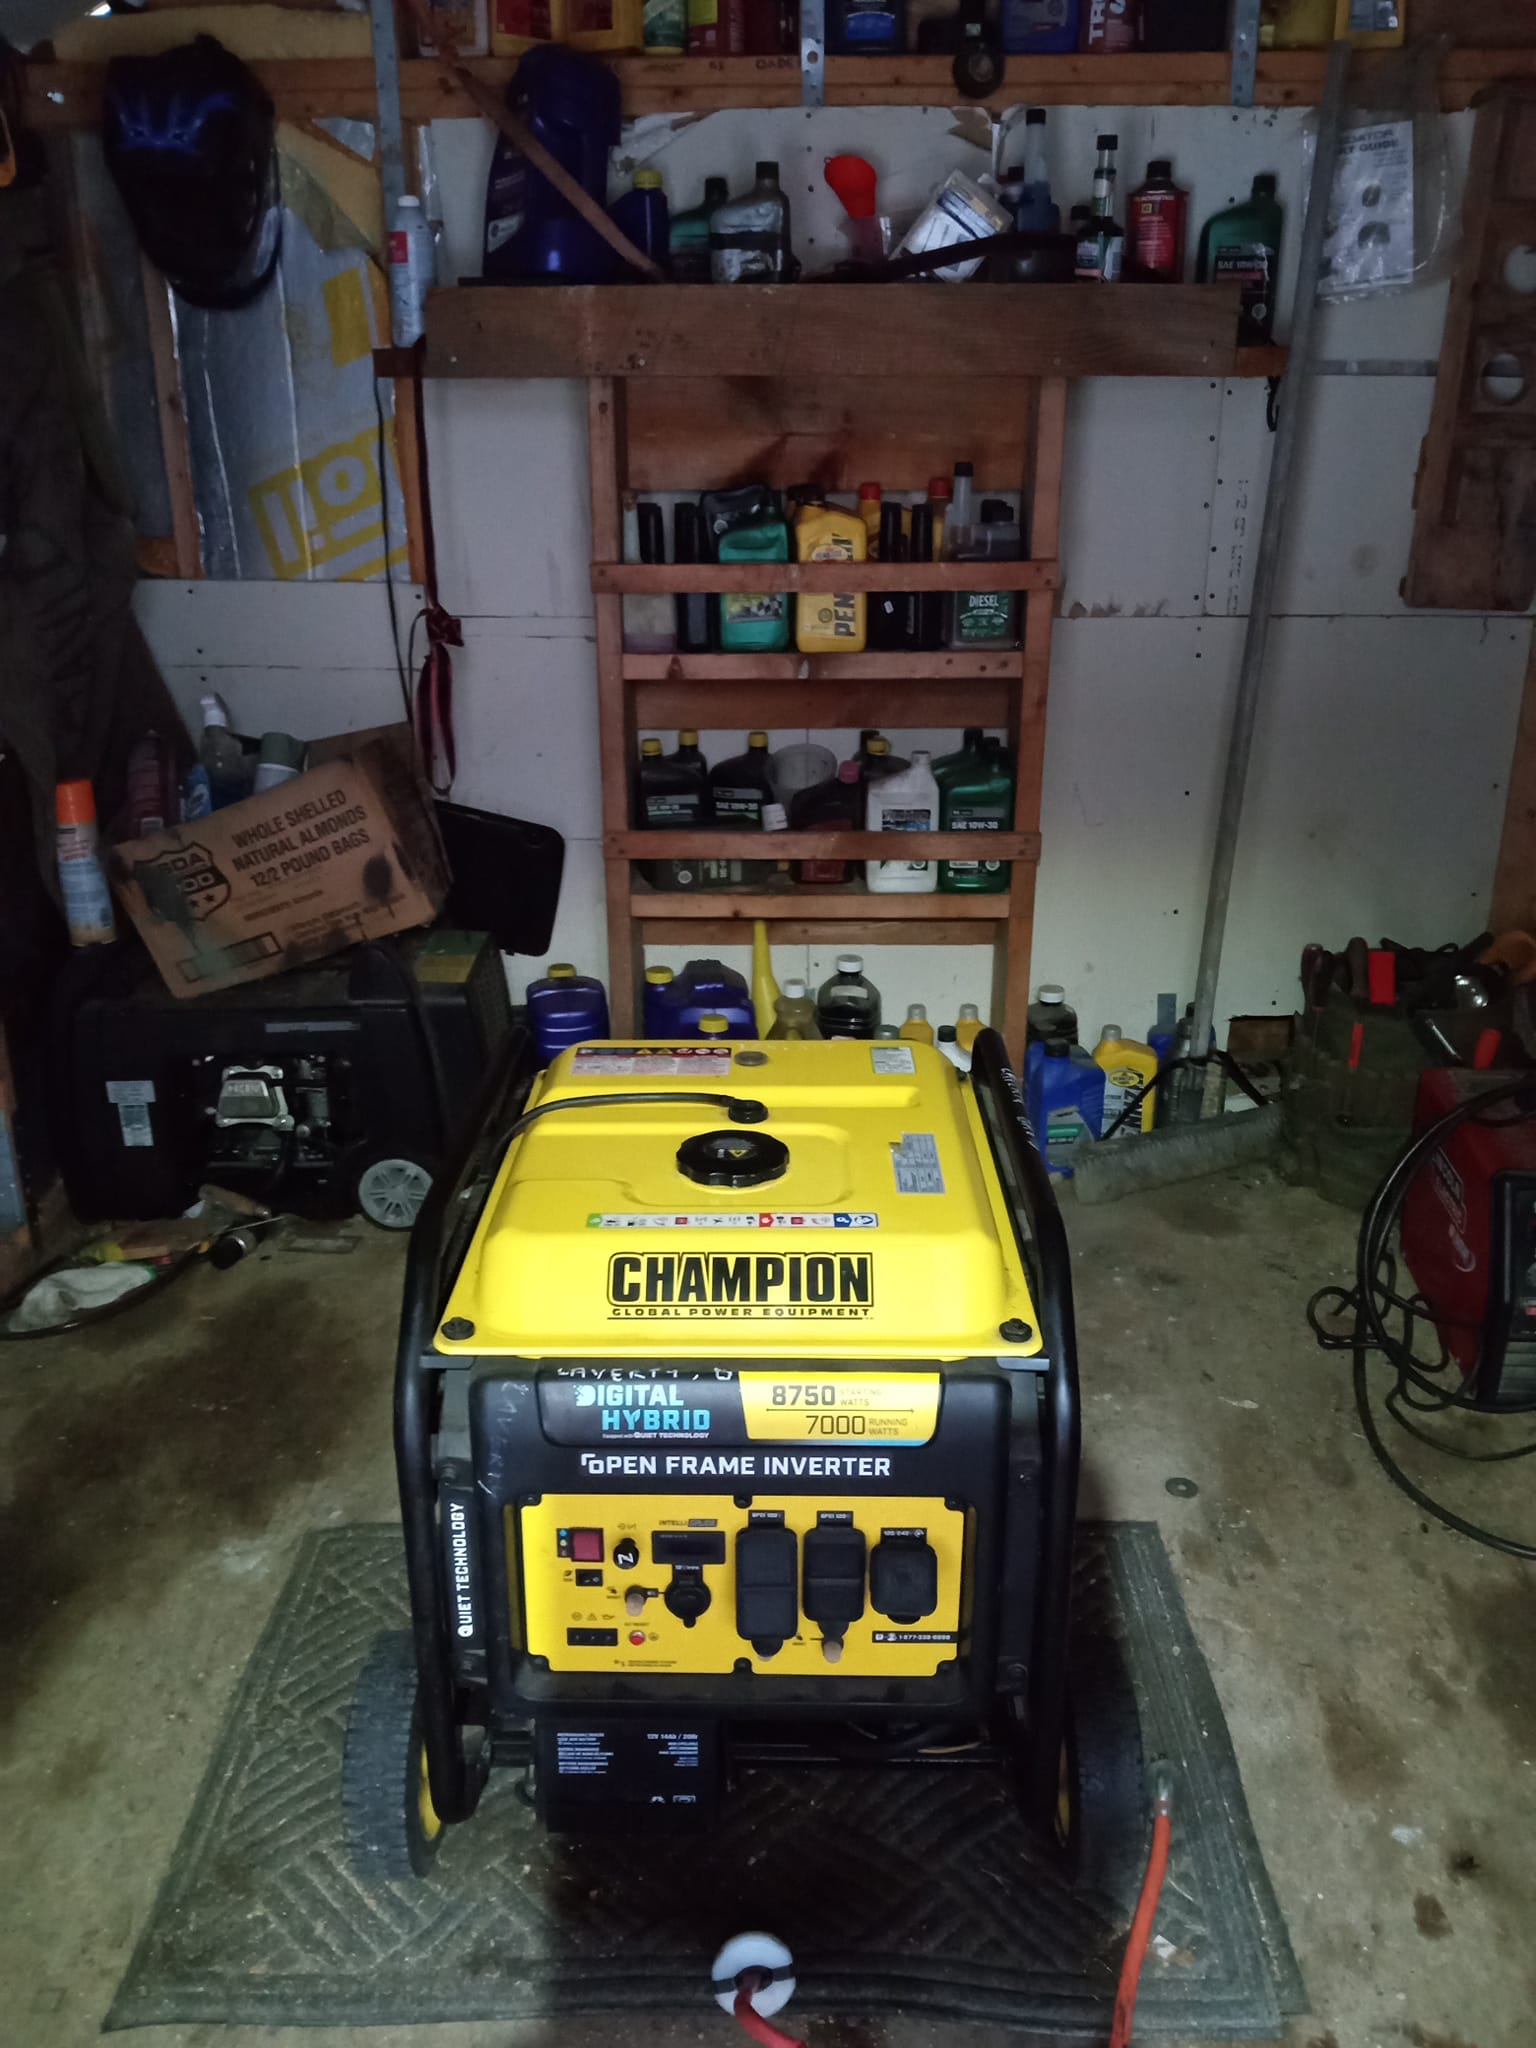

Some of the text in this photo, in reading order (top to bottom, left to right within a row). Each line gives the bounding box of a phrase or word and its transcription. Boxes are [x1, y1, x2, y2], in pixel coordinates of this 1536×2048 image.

[968, 594, 999, 608] DIESEL
[231, 789, 348, 848] WHOLE SHELLED
[232, 805, 368, 872] NATURAL ALMONDS
[250, 828, 371, 887] 12/2 POUND BAGS
[612, 1256, 869, 1303] CHAMPION
[612, 1308, 870, 1317] GLOBAL POWER EQUIPMENT
[573, 1384, 685, 1406] DIGITAL
[772, 1385, 836, 1406] 8750
[840, 1399, 870, 1407] WATTS
[602, 1409, 711, 1431] HYBRID
[806, 1415, 908, 1435] 7000 RUNNING
[868, 1428, 899, 1436] WATTS
[581, 1453, 891, 1477] OPEN FRAME INVERTER
[449, 1502, 474, 1638] QUIET TECHNOLOGY
